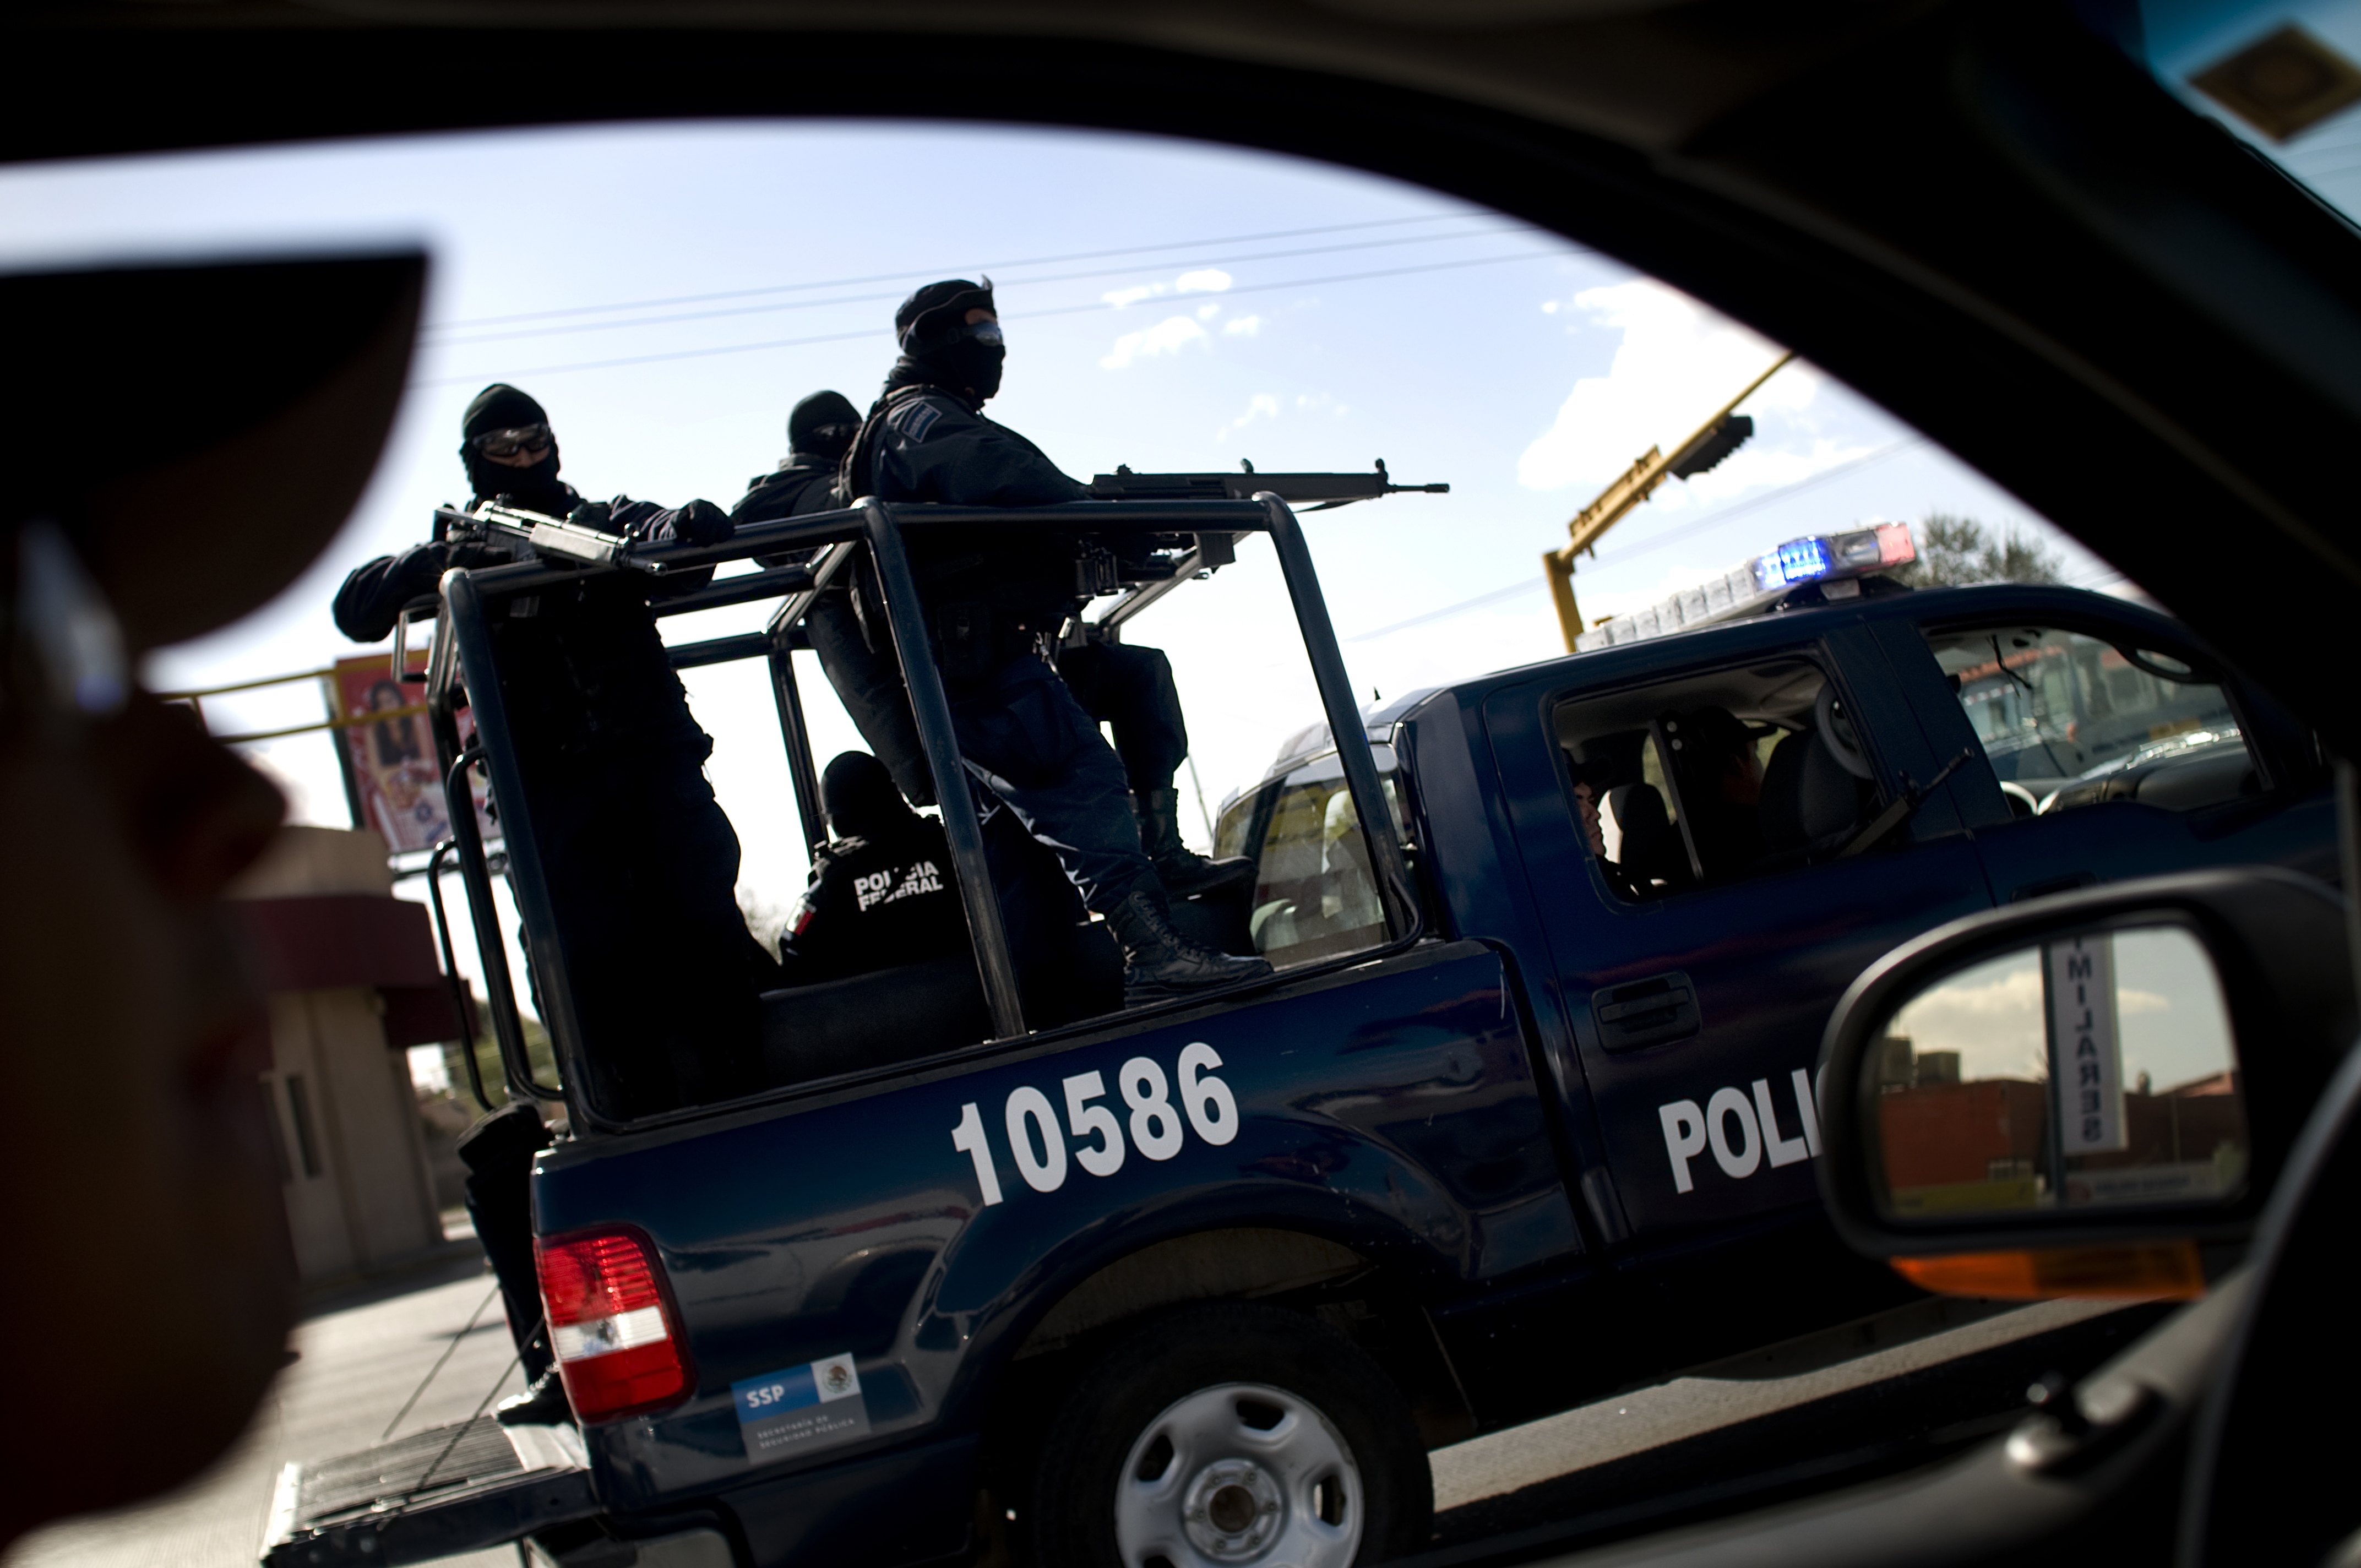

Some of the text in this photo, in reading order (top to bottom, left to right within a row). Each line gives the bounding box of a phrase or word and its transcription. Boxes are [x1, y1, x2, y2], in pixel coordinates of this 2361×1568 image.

[854, 861, 939, 896] POLCIA
[951, 1042, 1239, 1206] 10586
[1658, 1068, 1828, 1194] POLI
[746, 1384, 785, 1408] SSP
